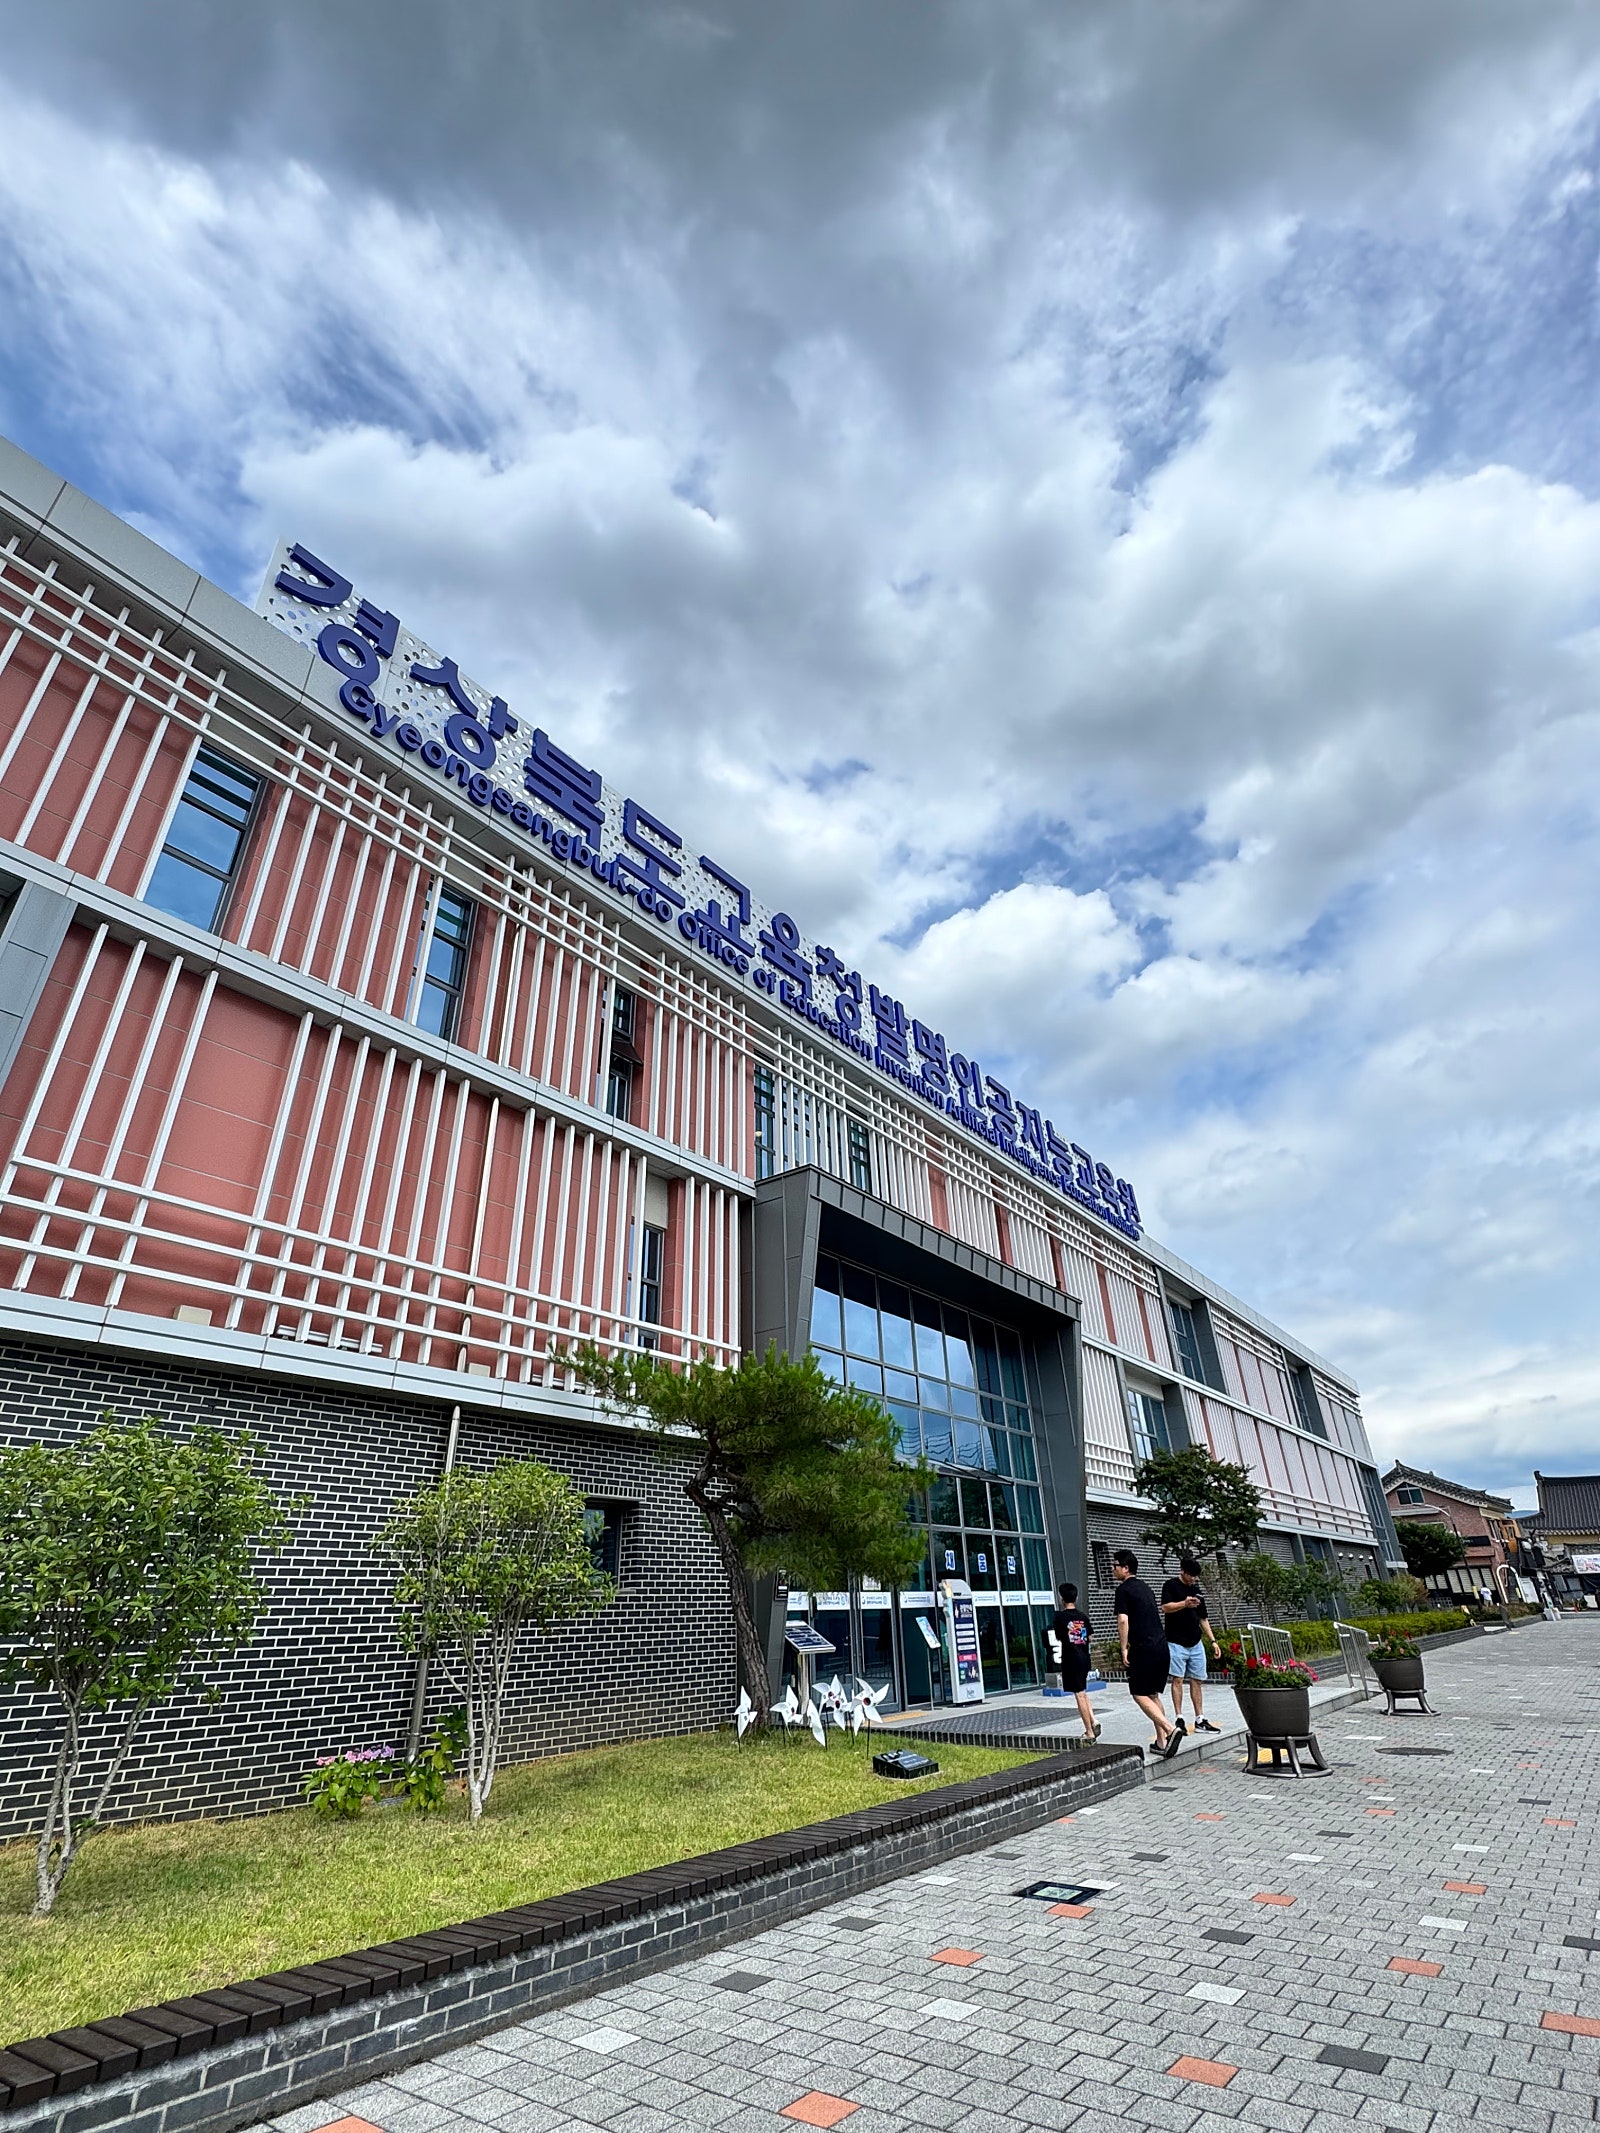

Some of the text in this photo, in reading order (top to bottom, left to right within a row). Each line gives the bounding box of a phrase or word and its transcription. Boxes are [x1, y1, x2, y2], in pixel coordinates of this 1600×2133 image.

[339, 678, 673, 922] Gyeongsangbuk-do
[678, 911, 749, 975] Office
[753, 968, 777, 995] of
[780, 979, 873, 1061] Education
[874, 1046, 944, 1110] Invention
[946, 1097, 1001, 1147] Artificial
[1000, 1132, 1061, 1188] Intelligence
